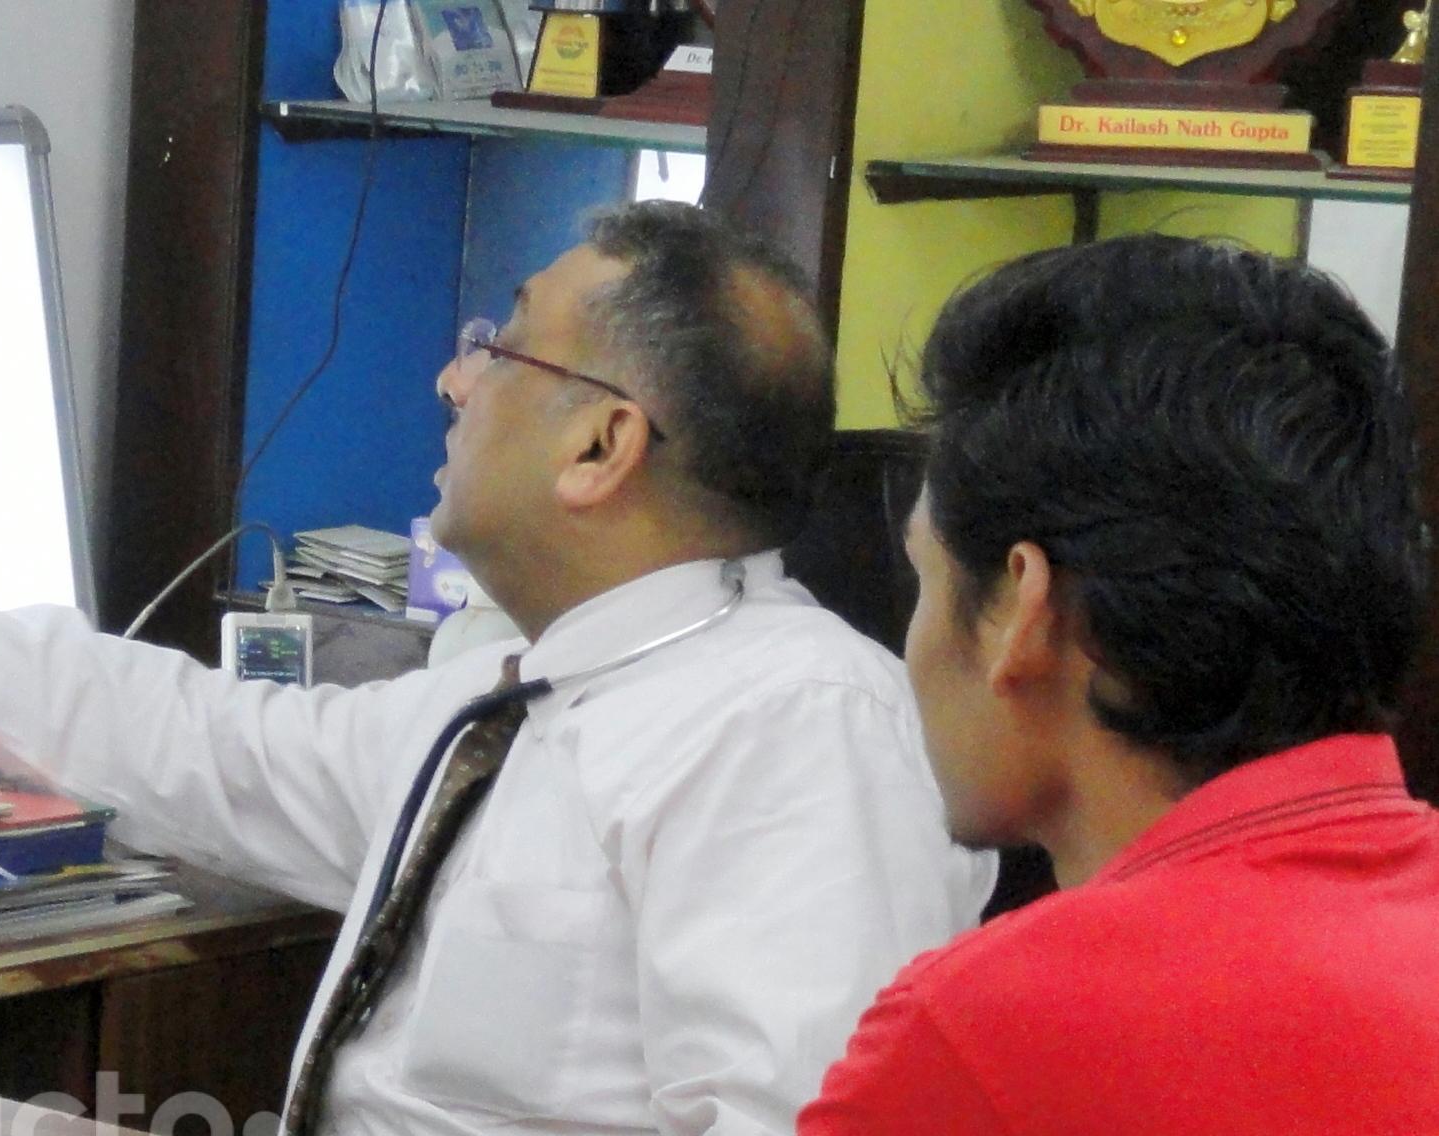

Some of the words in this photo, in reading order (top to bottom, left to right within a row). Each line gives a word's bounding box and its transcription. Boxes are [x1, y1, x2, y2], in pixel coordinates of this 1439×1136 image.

[1059, 114, 1090, 133] Dr.
[1098, 116, 1169, 135] Kailash
[1176, 118, 1222, 138] Nath
[1229, 120, 1289, 143] Gupta
